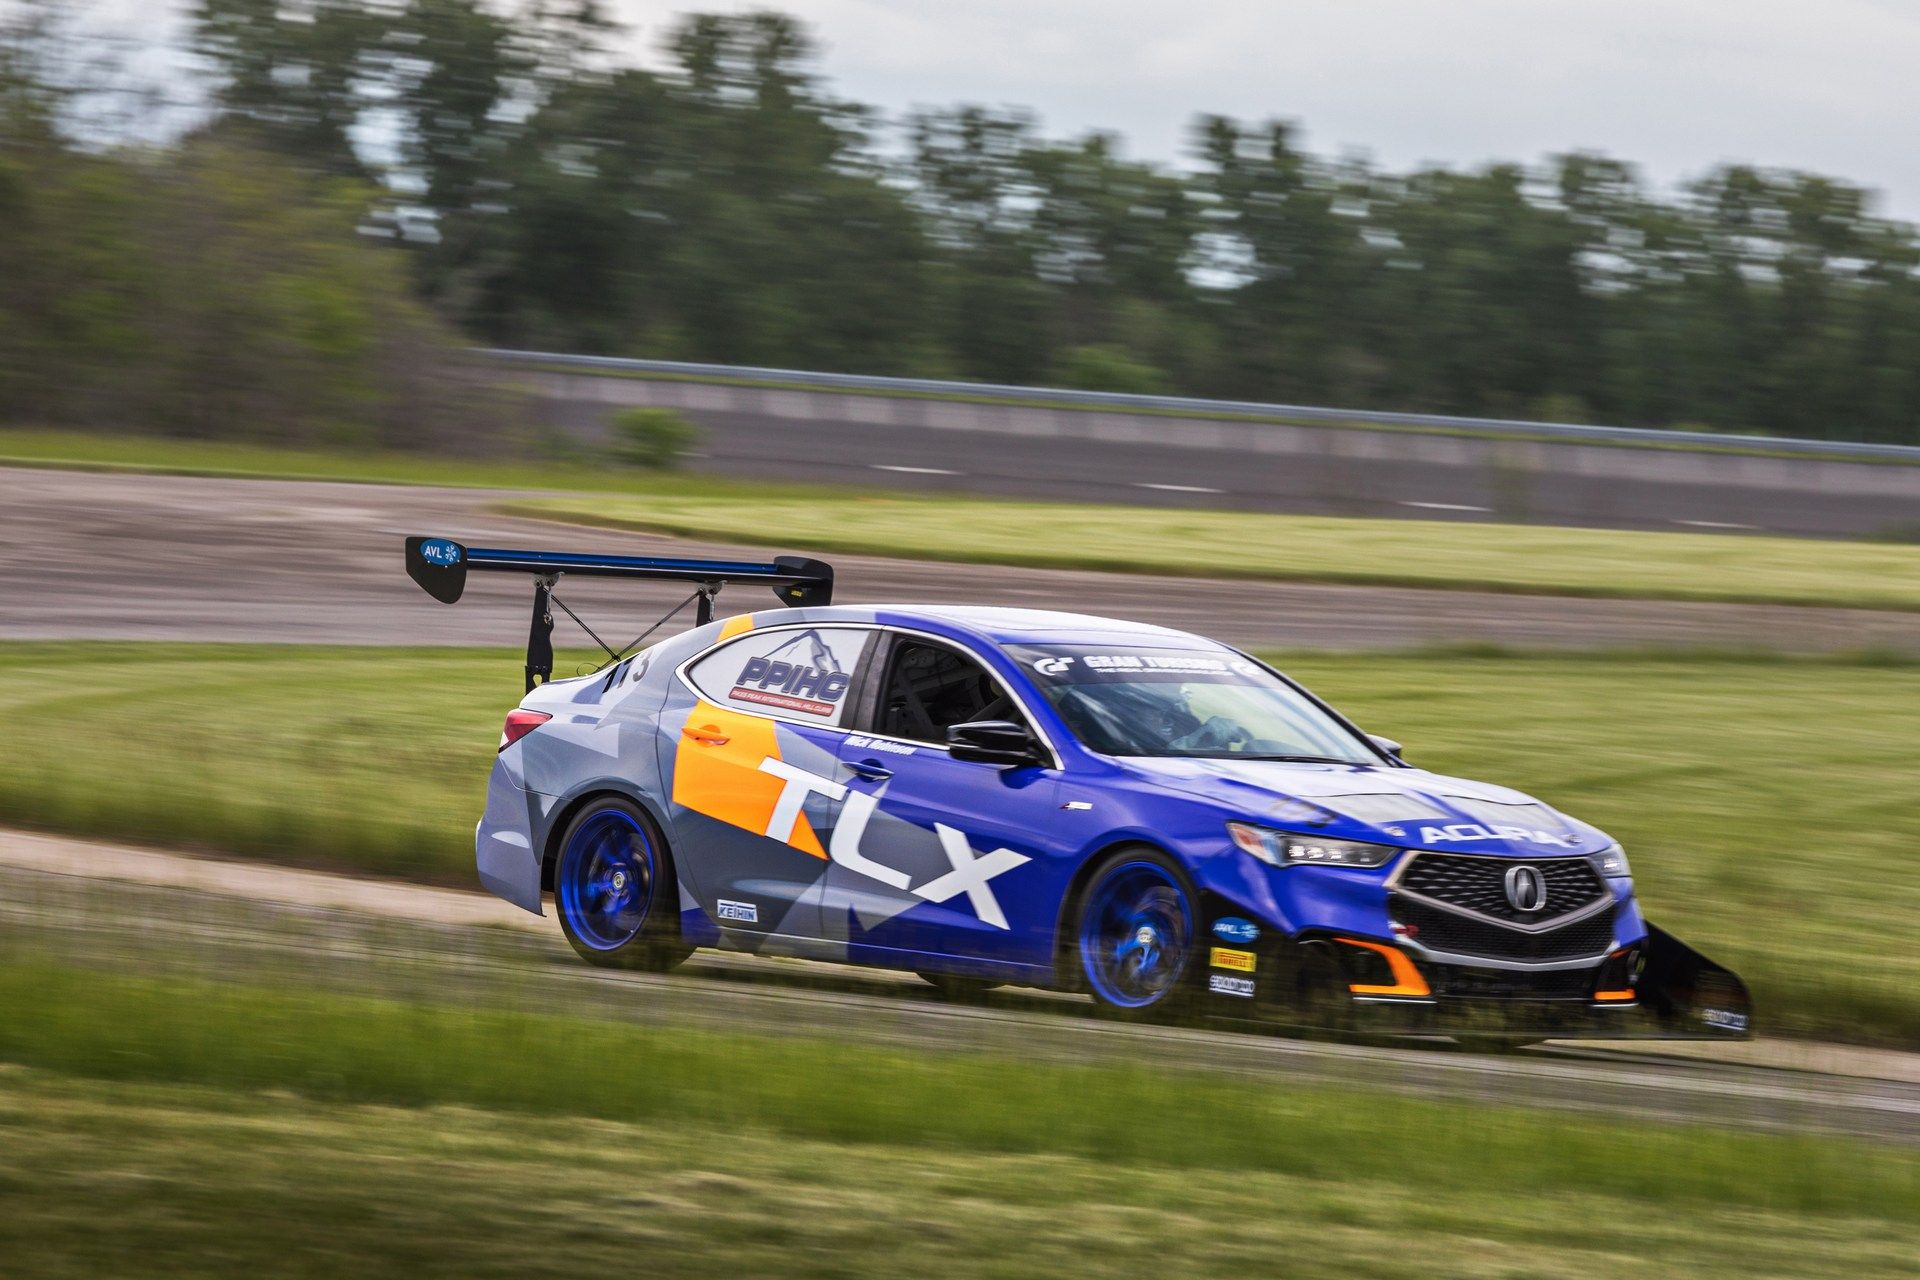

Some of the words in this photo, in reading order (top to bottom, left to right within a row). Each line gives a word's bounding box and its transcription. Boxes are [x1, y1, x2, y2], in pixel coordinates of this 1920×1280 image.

[424, 545, 442, 559] AVL
[736, 656, 852, 702] PPIHC
[758, 756, 1032, 930] TLX
[1419, 824, 1575, 848] ACURA
[719, 904, 755, 921] KEIHIN
